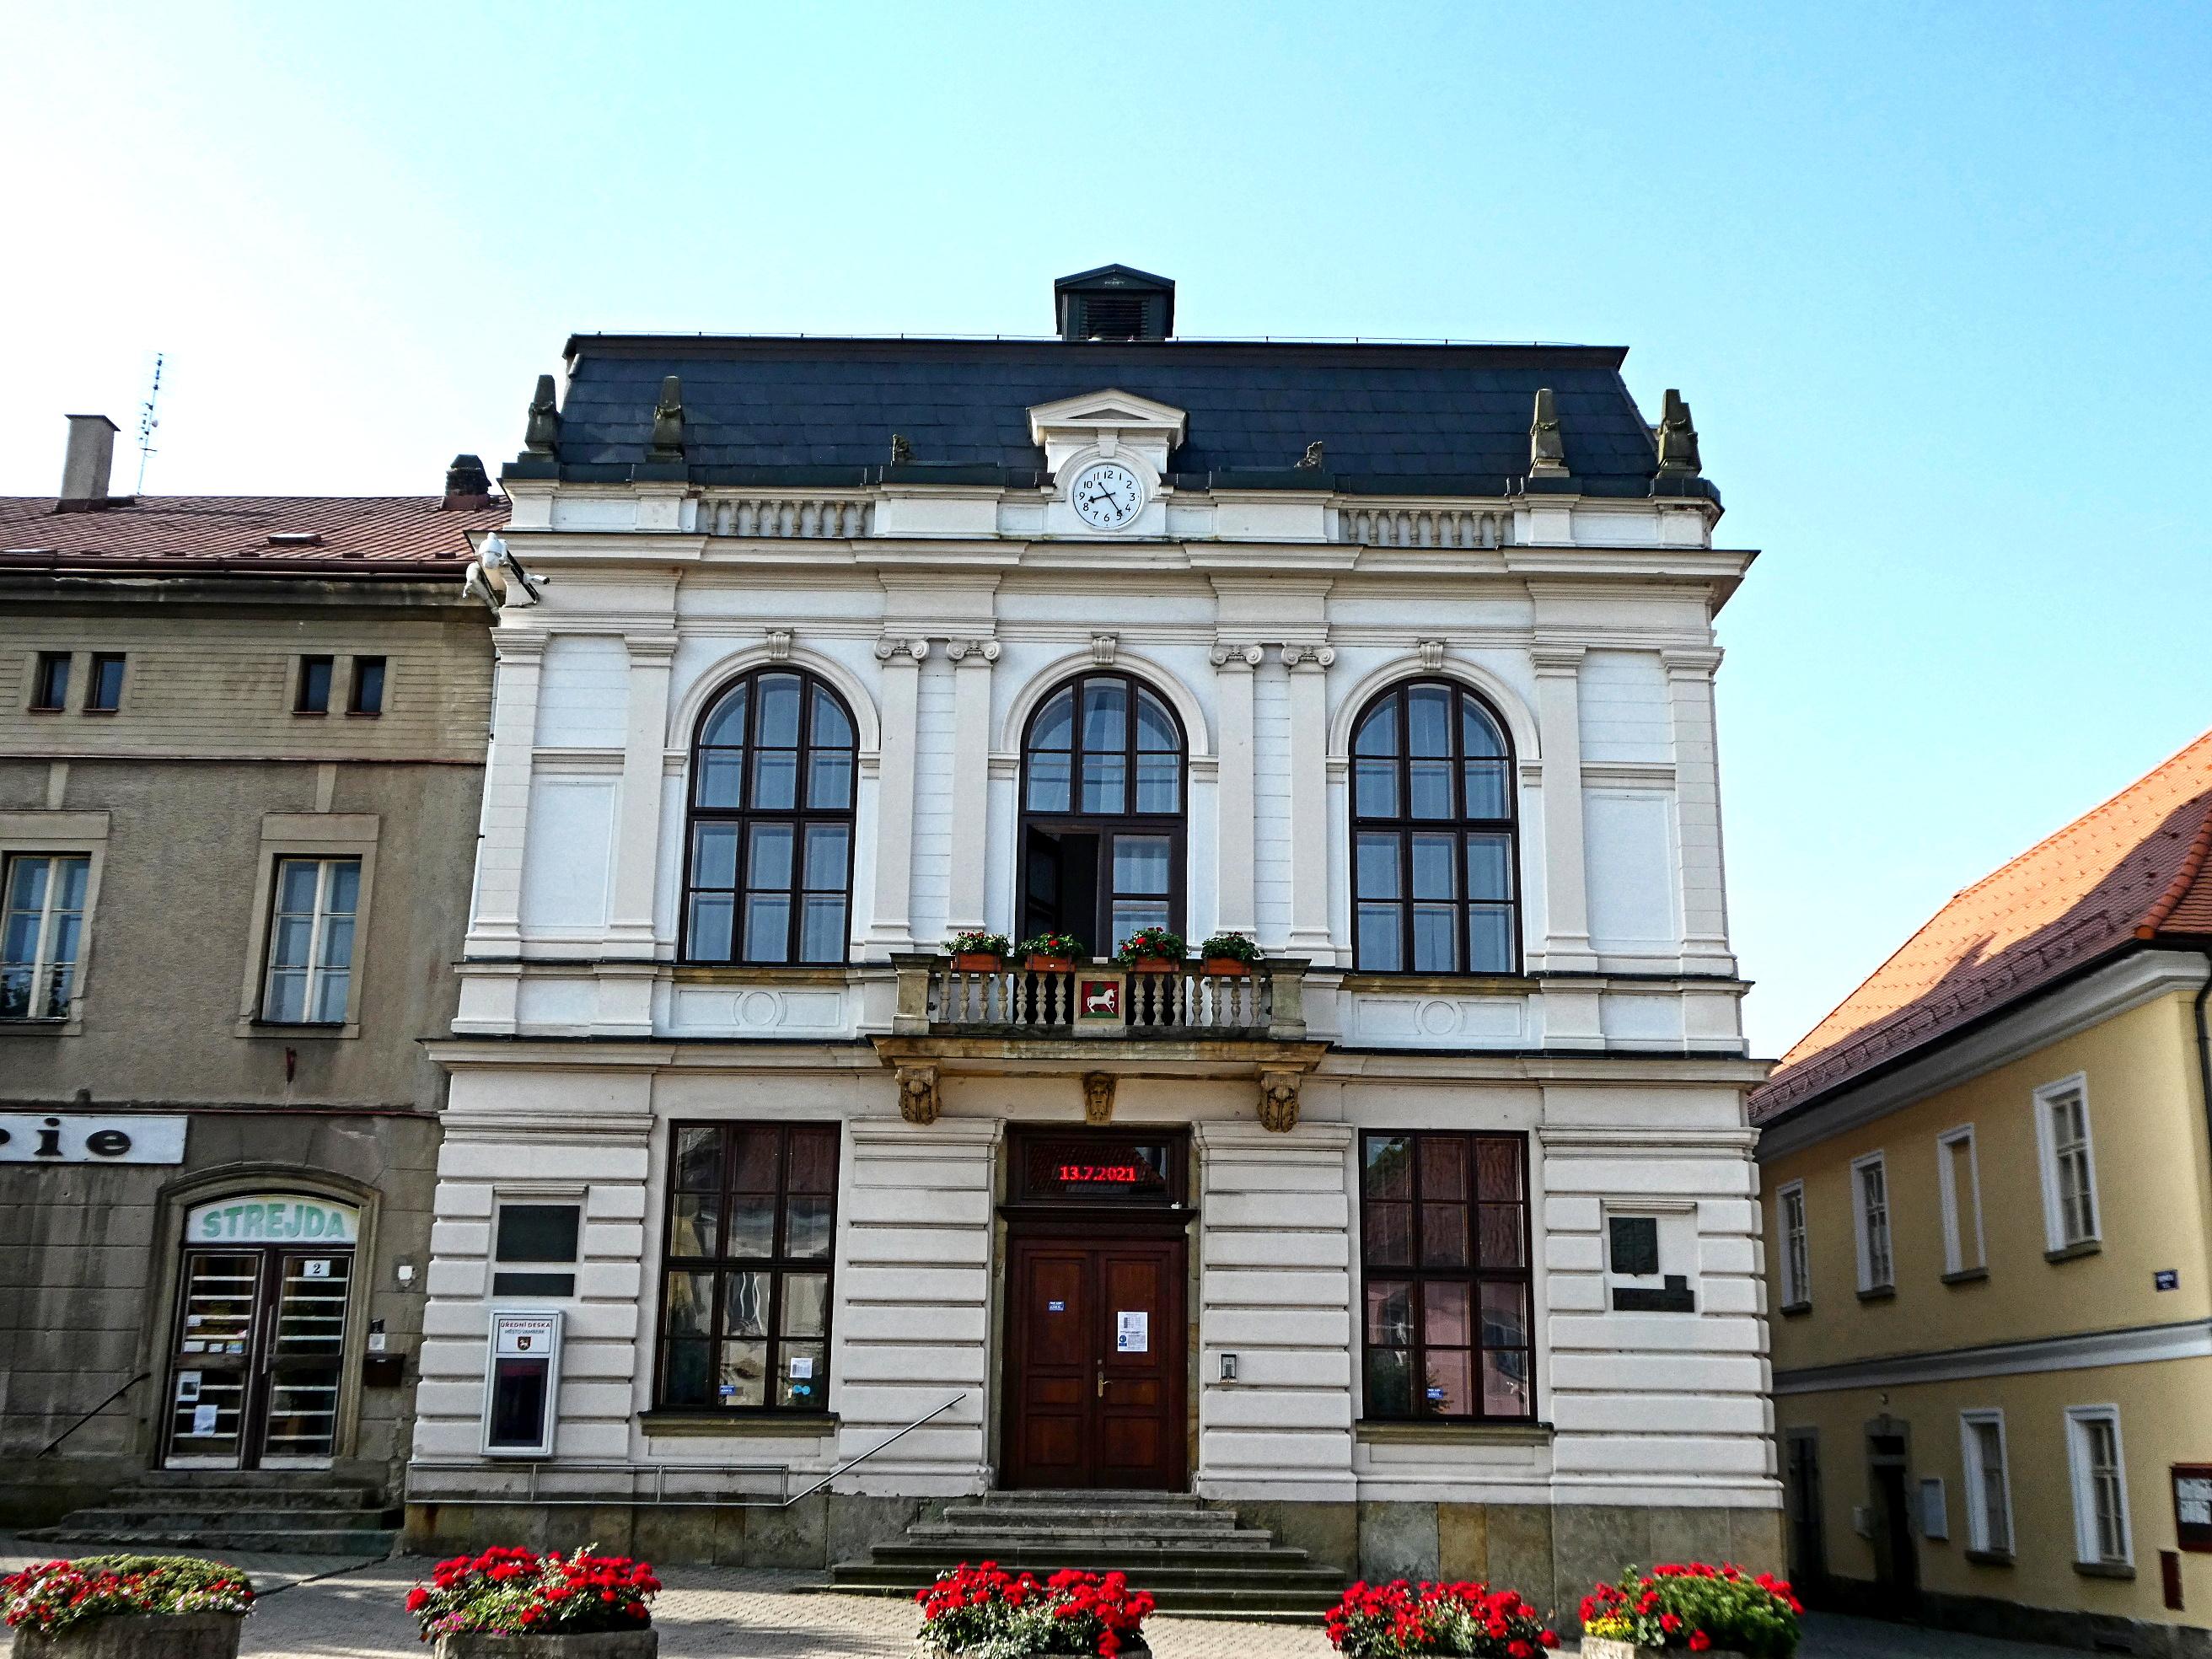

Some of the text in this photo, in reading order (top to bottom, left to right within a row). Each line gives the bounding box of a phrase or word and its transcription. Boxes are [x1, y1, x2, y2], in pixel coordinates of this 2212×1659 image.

[1093, 472, 1100, 481] 11
[1103, 470, 1114, 480] 12
[1083, 481, 1093, 489] 10
[1126, 481, 1132, 489] 2
[1079, 491, 1085, 500] 9
[1130, 492, 1136, 502] 3
[1082, 502, 1089, 512] 8
[1125, 503, 1131, 512] 4
[1093, 511, 1098, 519] 7
[1103, 513, 1110, 522] 6
[0, 1117, 132, 1157] ie
[1060, 1166, 1136, 1181] 13.7.2021
[202, 1203, 345, 1238] STREJDA
[313, 1263, 321, 1274] 2
